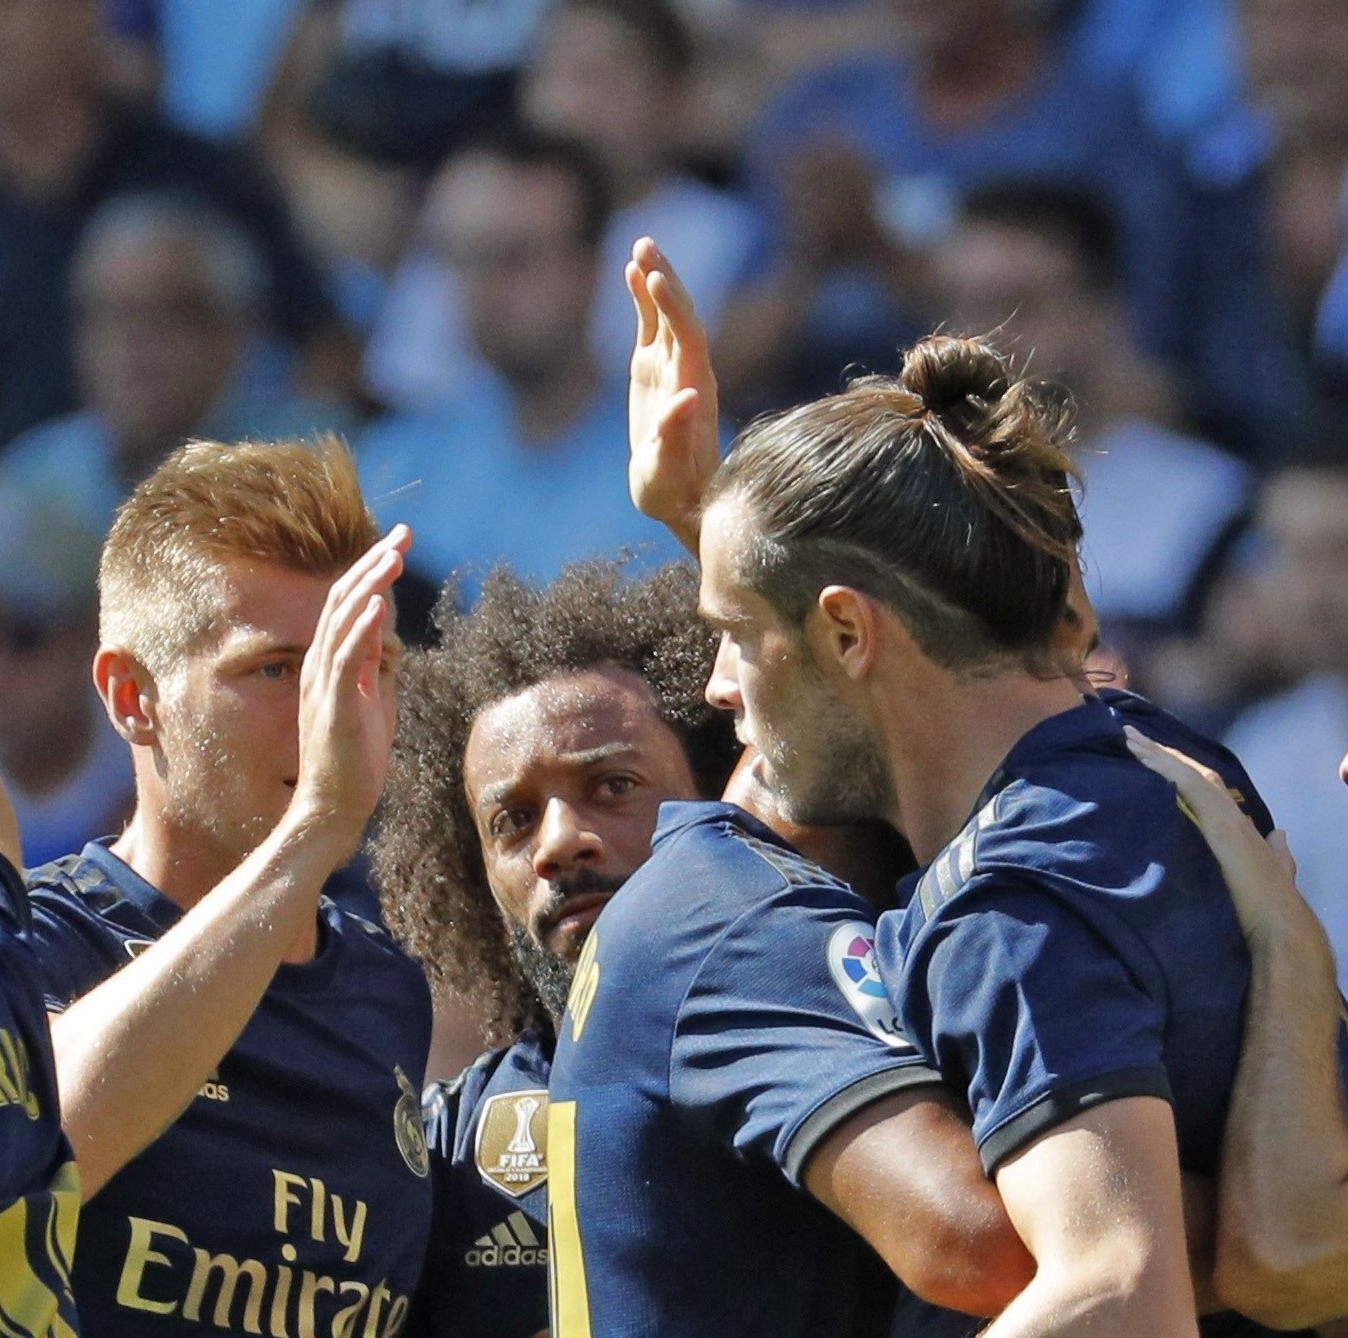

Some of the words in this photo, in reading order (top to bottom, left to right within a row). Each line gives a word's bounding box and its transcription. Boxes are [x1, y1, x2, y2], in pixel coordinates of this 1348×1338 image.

[499, 1153, 540, 1168] FIFA
[272, 1168, 368, 1263] Fly
[464, 1244, 548, 1268] adidas
